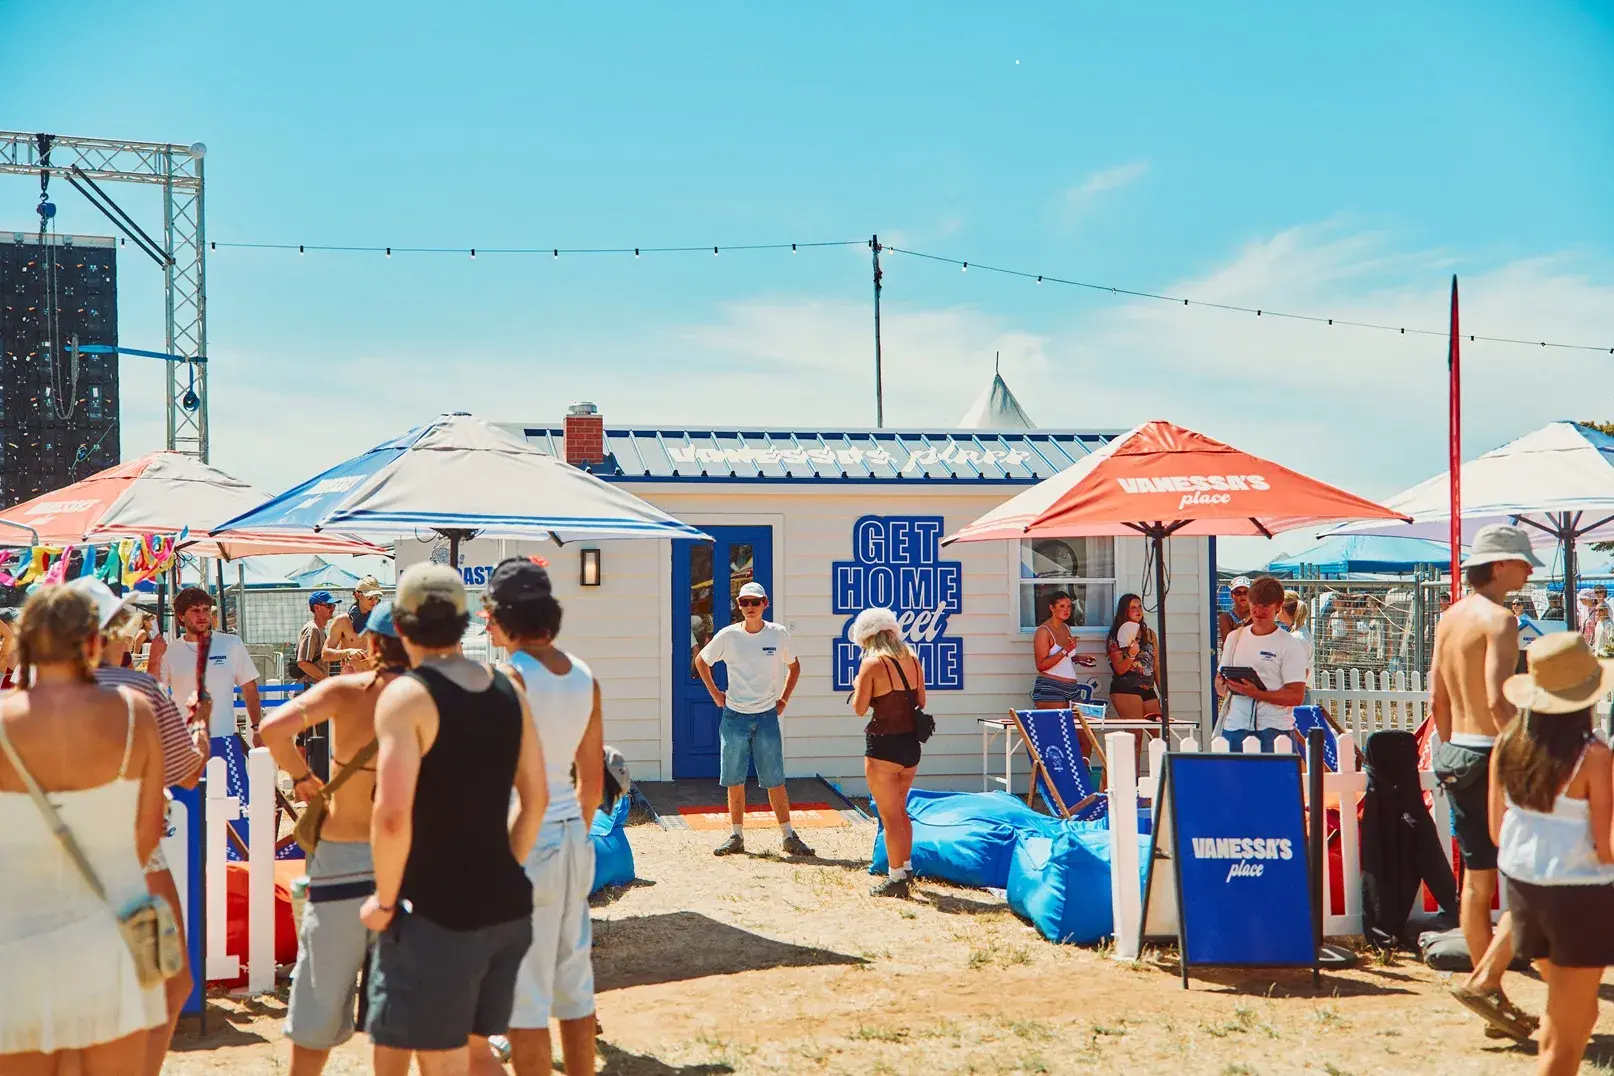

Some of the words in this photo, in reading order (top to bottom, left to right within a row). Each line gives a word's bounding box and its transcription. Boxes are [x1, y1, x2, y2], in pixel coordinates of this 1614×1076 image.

[901, 440, 1032, 473] place
[1117, 474, 1271, 494] VANESSA'S
[1178, 490, 1232, 511] place
[858, 520, 940, 565] GET
[457, 566, 494, 586] AST
[837, 566, 959, 610] HOME
[837, 643, 959, 687] HME
[1192, 838, 1293, 860] VANESSA'S
[1226, 859, 1265, 883] place
